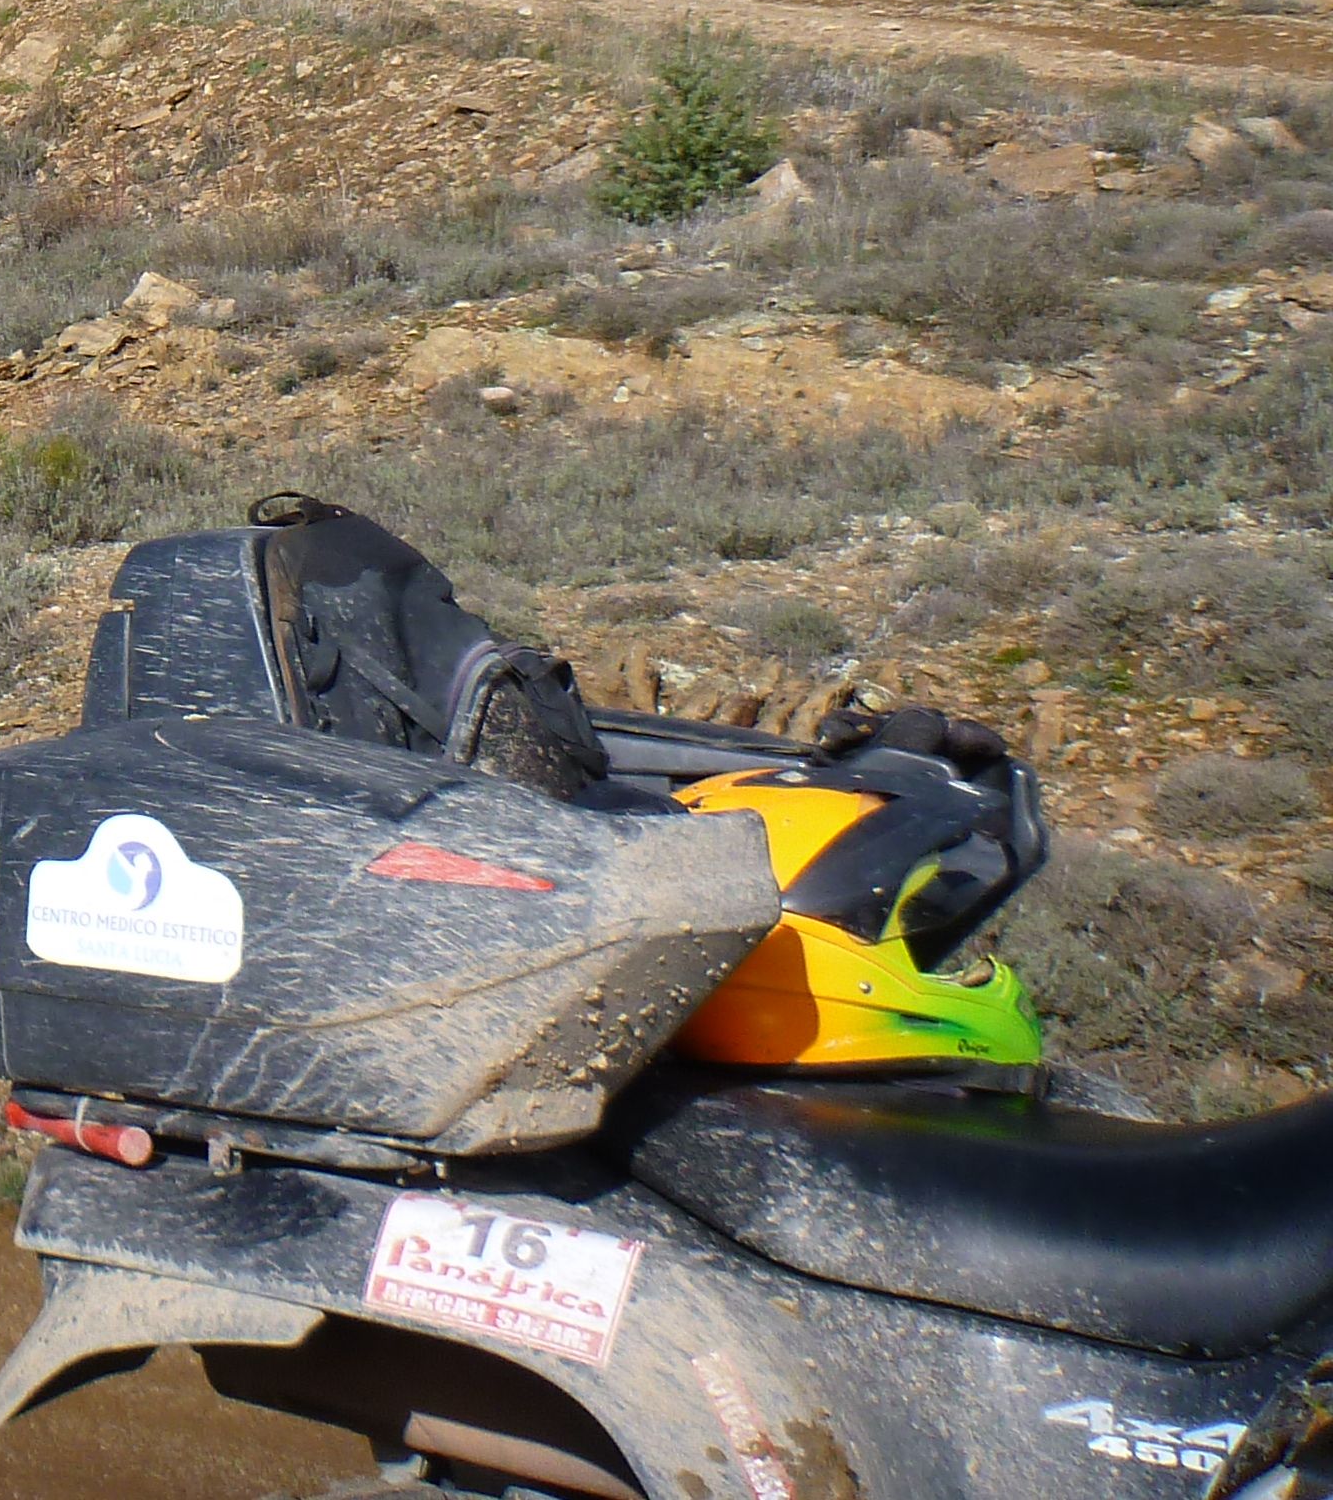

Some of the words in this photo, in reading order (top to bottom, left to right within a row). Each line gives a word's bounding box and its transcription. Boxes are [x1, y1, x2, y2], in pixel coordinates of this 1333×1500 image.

[31, 905, 92, 928] CENTRO
[95, 913, 158, 936] MEDICO
[162, 922, 238, 947] ESTETICO
[77, 937, 130, 960] SANTA
[134, 945, 183, 968] LUCIA
[460, 1211, 552, 1270] 16
[382, 1280, 487, 1325] AFRICAN
[1087, 1434, 1225, 1474] 450
